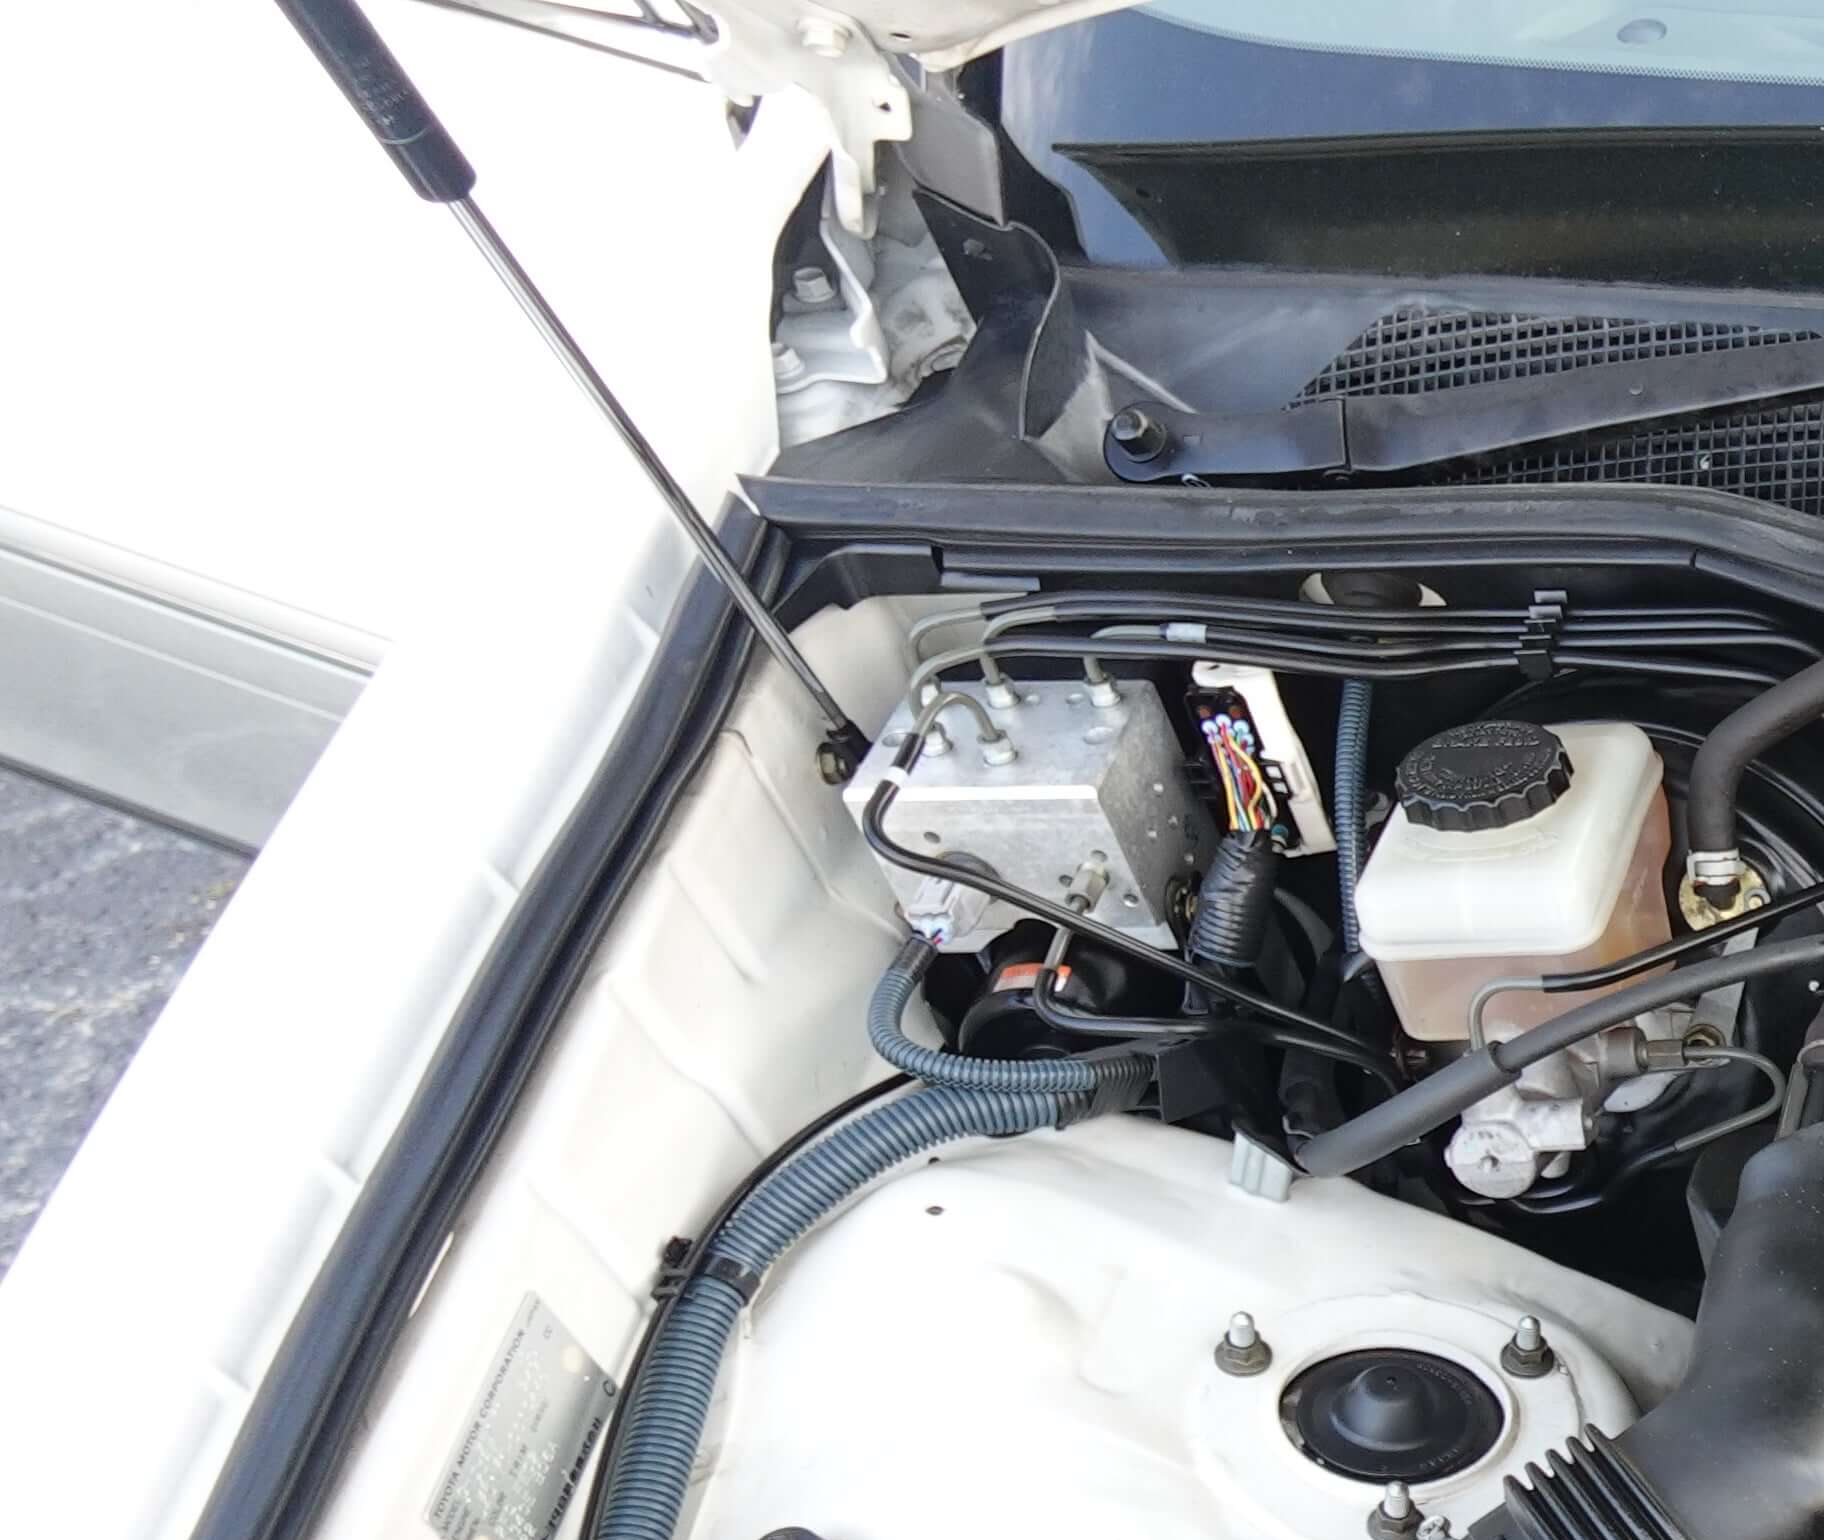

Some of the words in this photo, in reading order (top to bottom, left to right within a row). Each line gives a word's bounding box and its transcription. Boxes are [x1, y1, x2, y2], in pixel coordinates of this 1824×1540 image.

[432, 1470, 461, 1520] TOYOTA
[456, 1418, 483, 1468] MOTOR
[478, 1328, 526, 1420] CORPORATION
